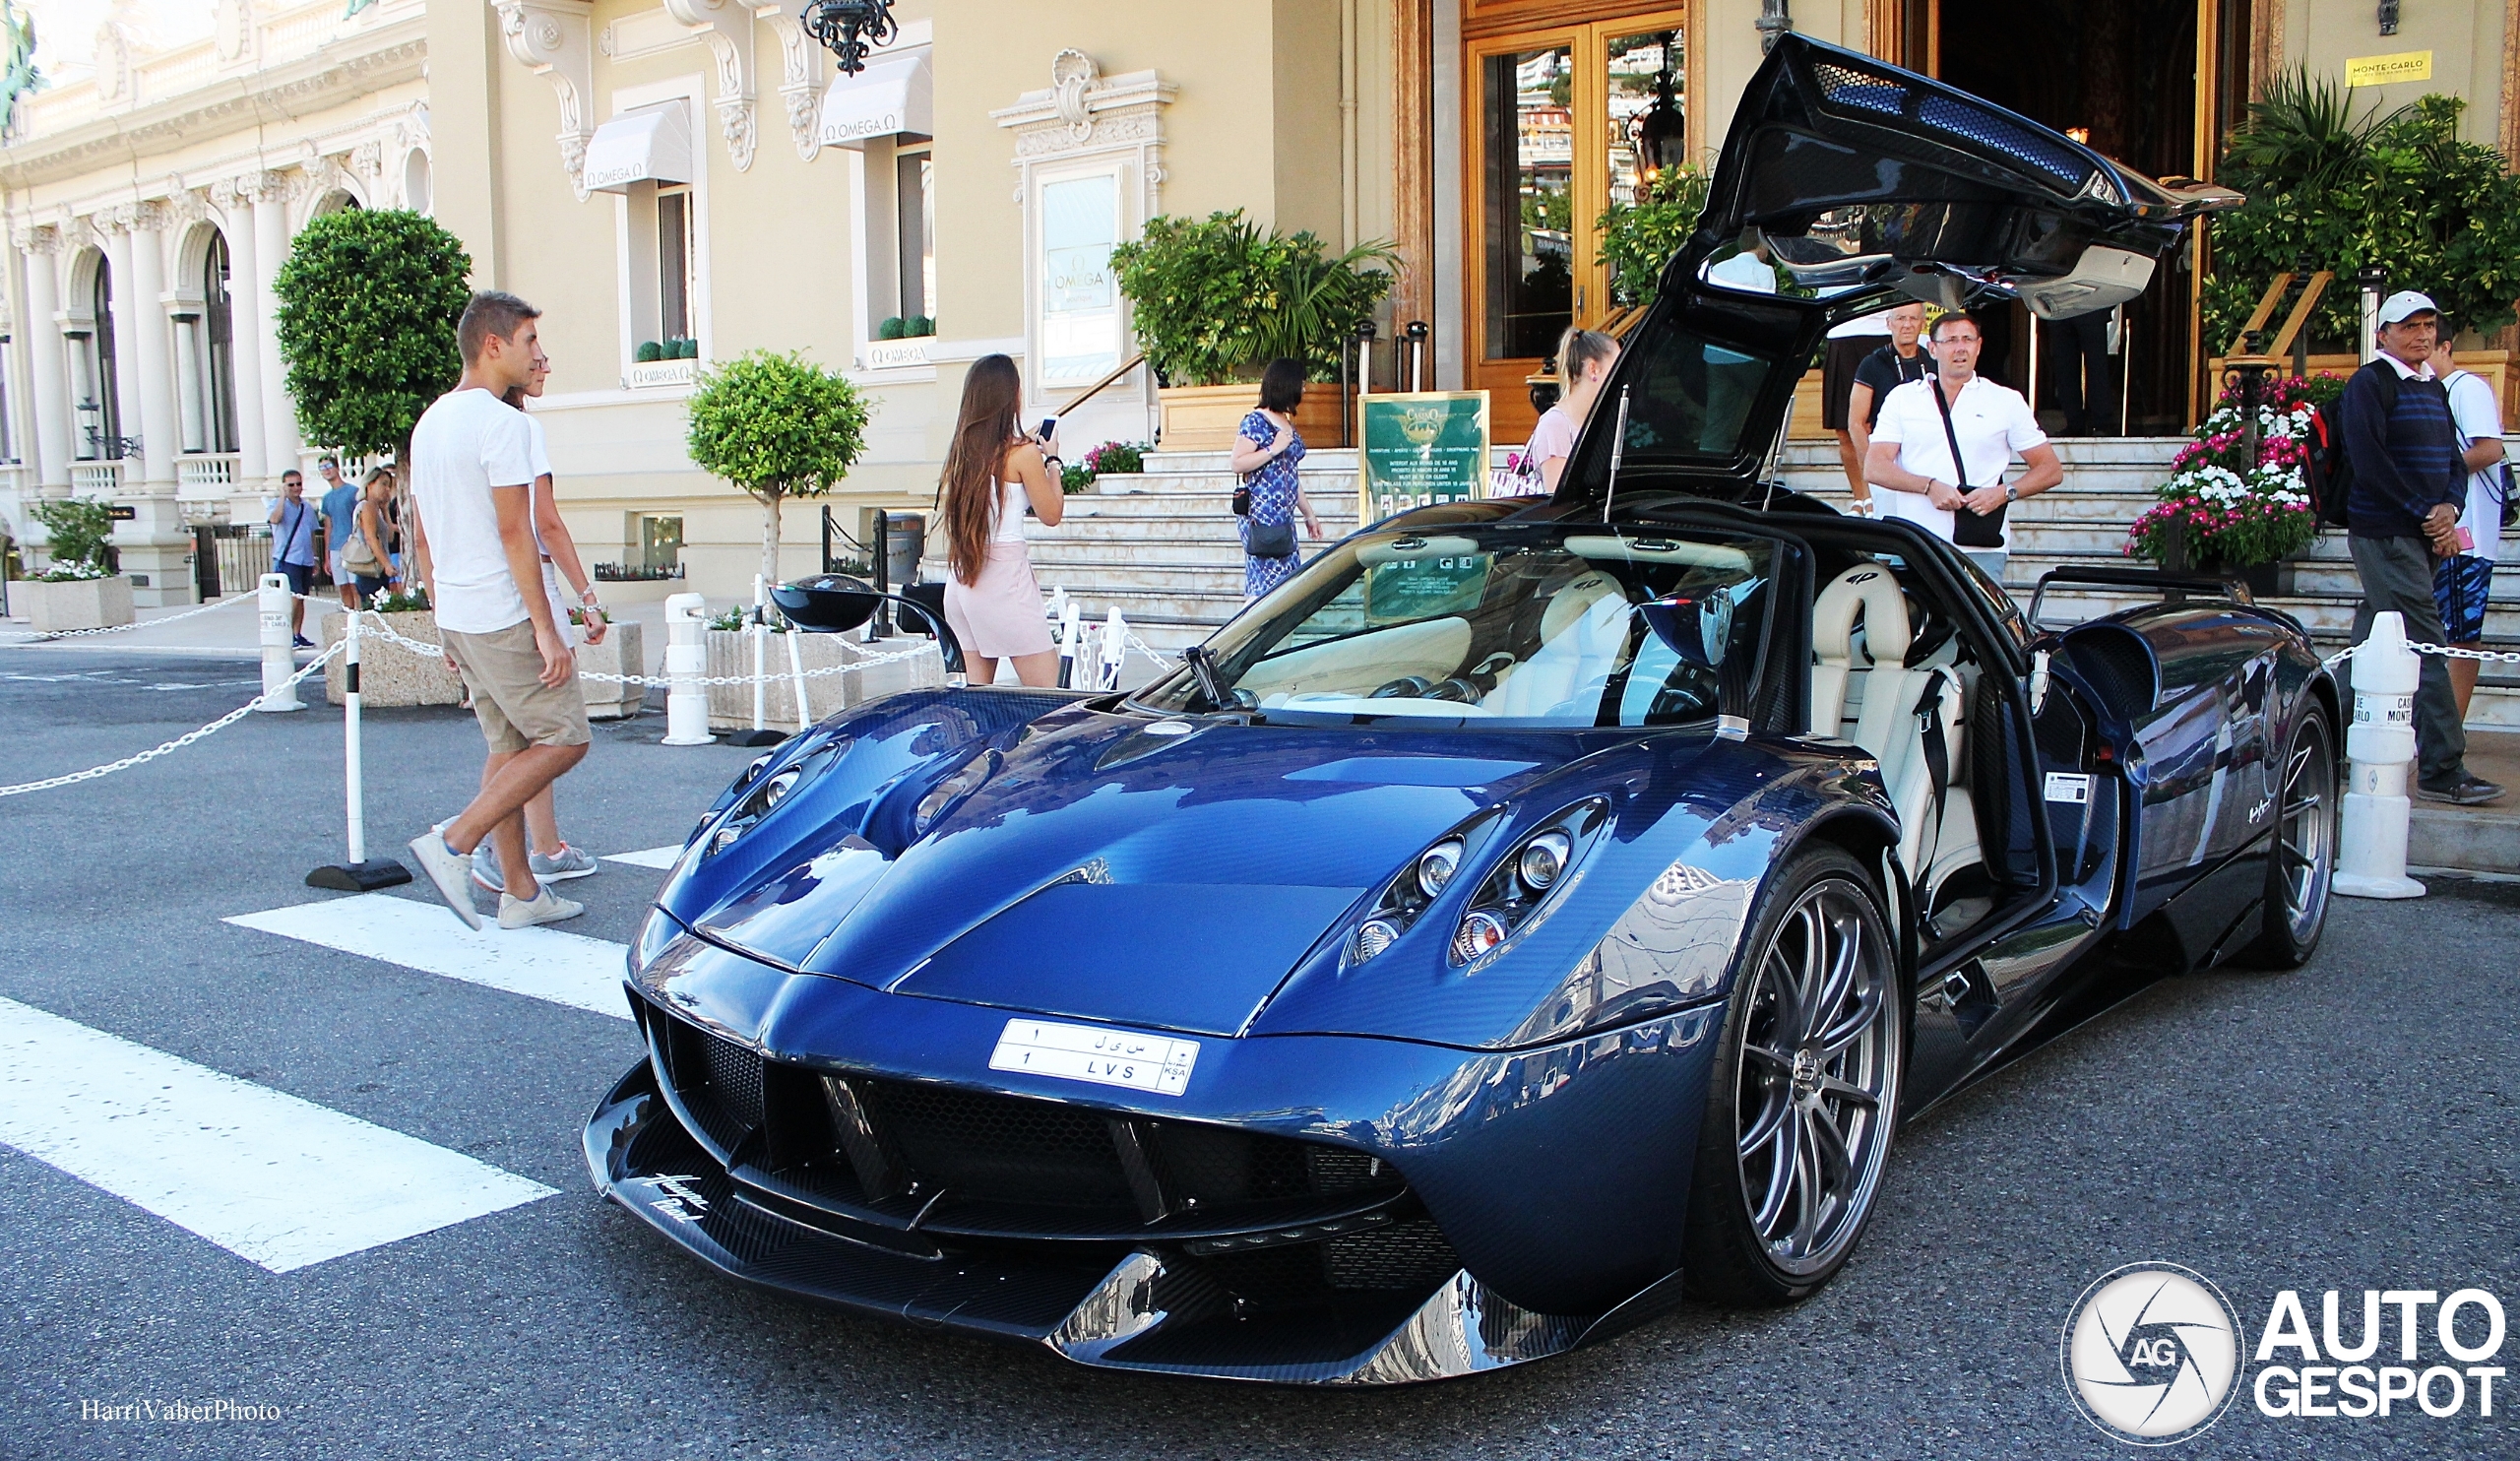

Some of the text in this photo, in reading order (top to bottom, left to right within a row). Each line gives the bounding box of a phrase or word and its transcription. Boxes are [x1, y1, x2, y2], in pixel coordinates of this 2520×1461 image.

[2353, 60, 2423, 74] MONTE-CARLO
[838, 119, 882, 138] OMEGA
[597, 168, 630, 184] OMEGA
[1055, 271, 1104, 289] OMEGA
[885, 347, 927, 363] OMEGA
[644, 367, 677, 381] OMEGA
[1023, 1052, 1031, 1064] 1
[1165, 1067, 1185, 1077] KSA
